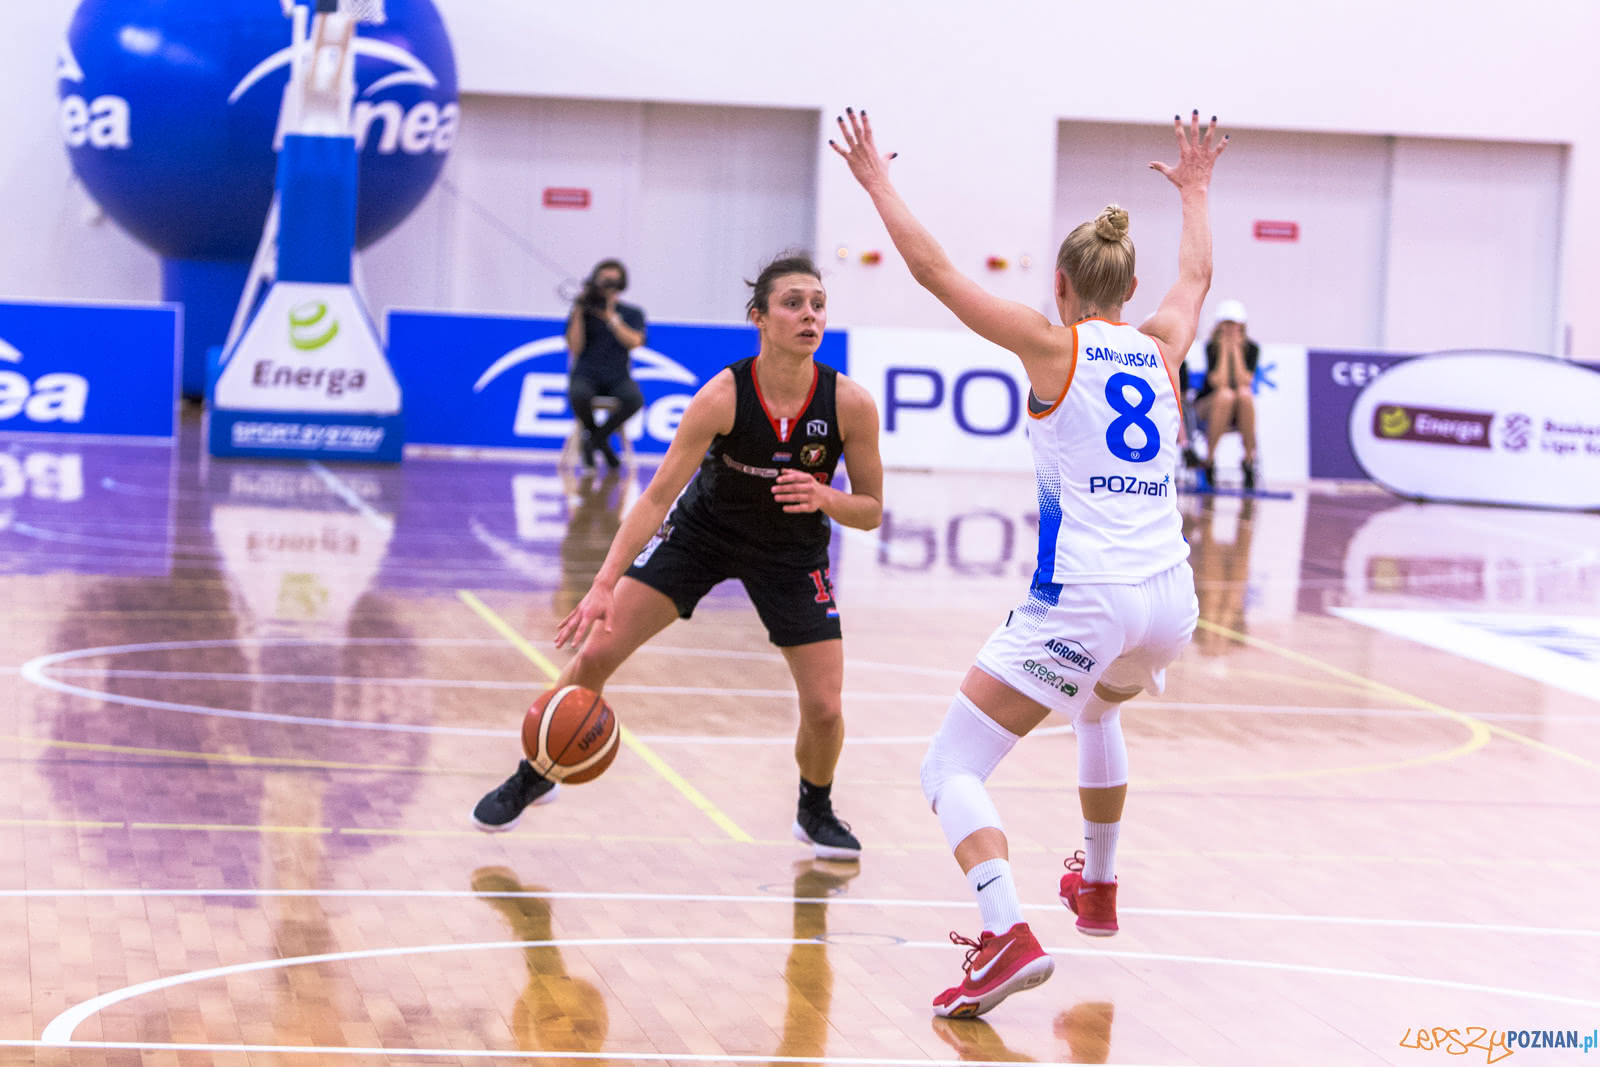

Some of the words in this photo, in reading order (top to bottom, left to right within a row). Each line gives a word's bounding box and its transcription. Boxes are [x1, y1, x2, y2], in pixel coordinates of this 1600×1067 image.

[253, 360, 367, 398] Energa
[884, 367, 1030, 439] PO
[1105, 372, 1161, 463] 8
[1414, 413, 1485, 443] Energa
[1023, 659, 1064, 686] green
[1044, 638, 1095, 672] AGROBEX
